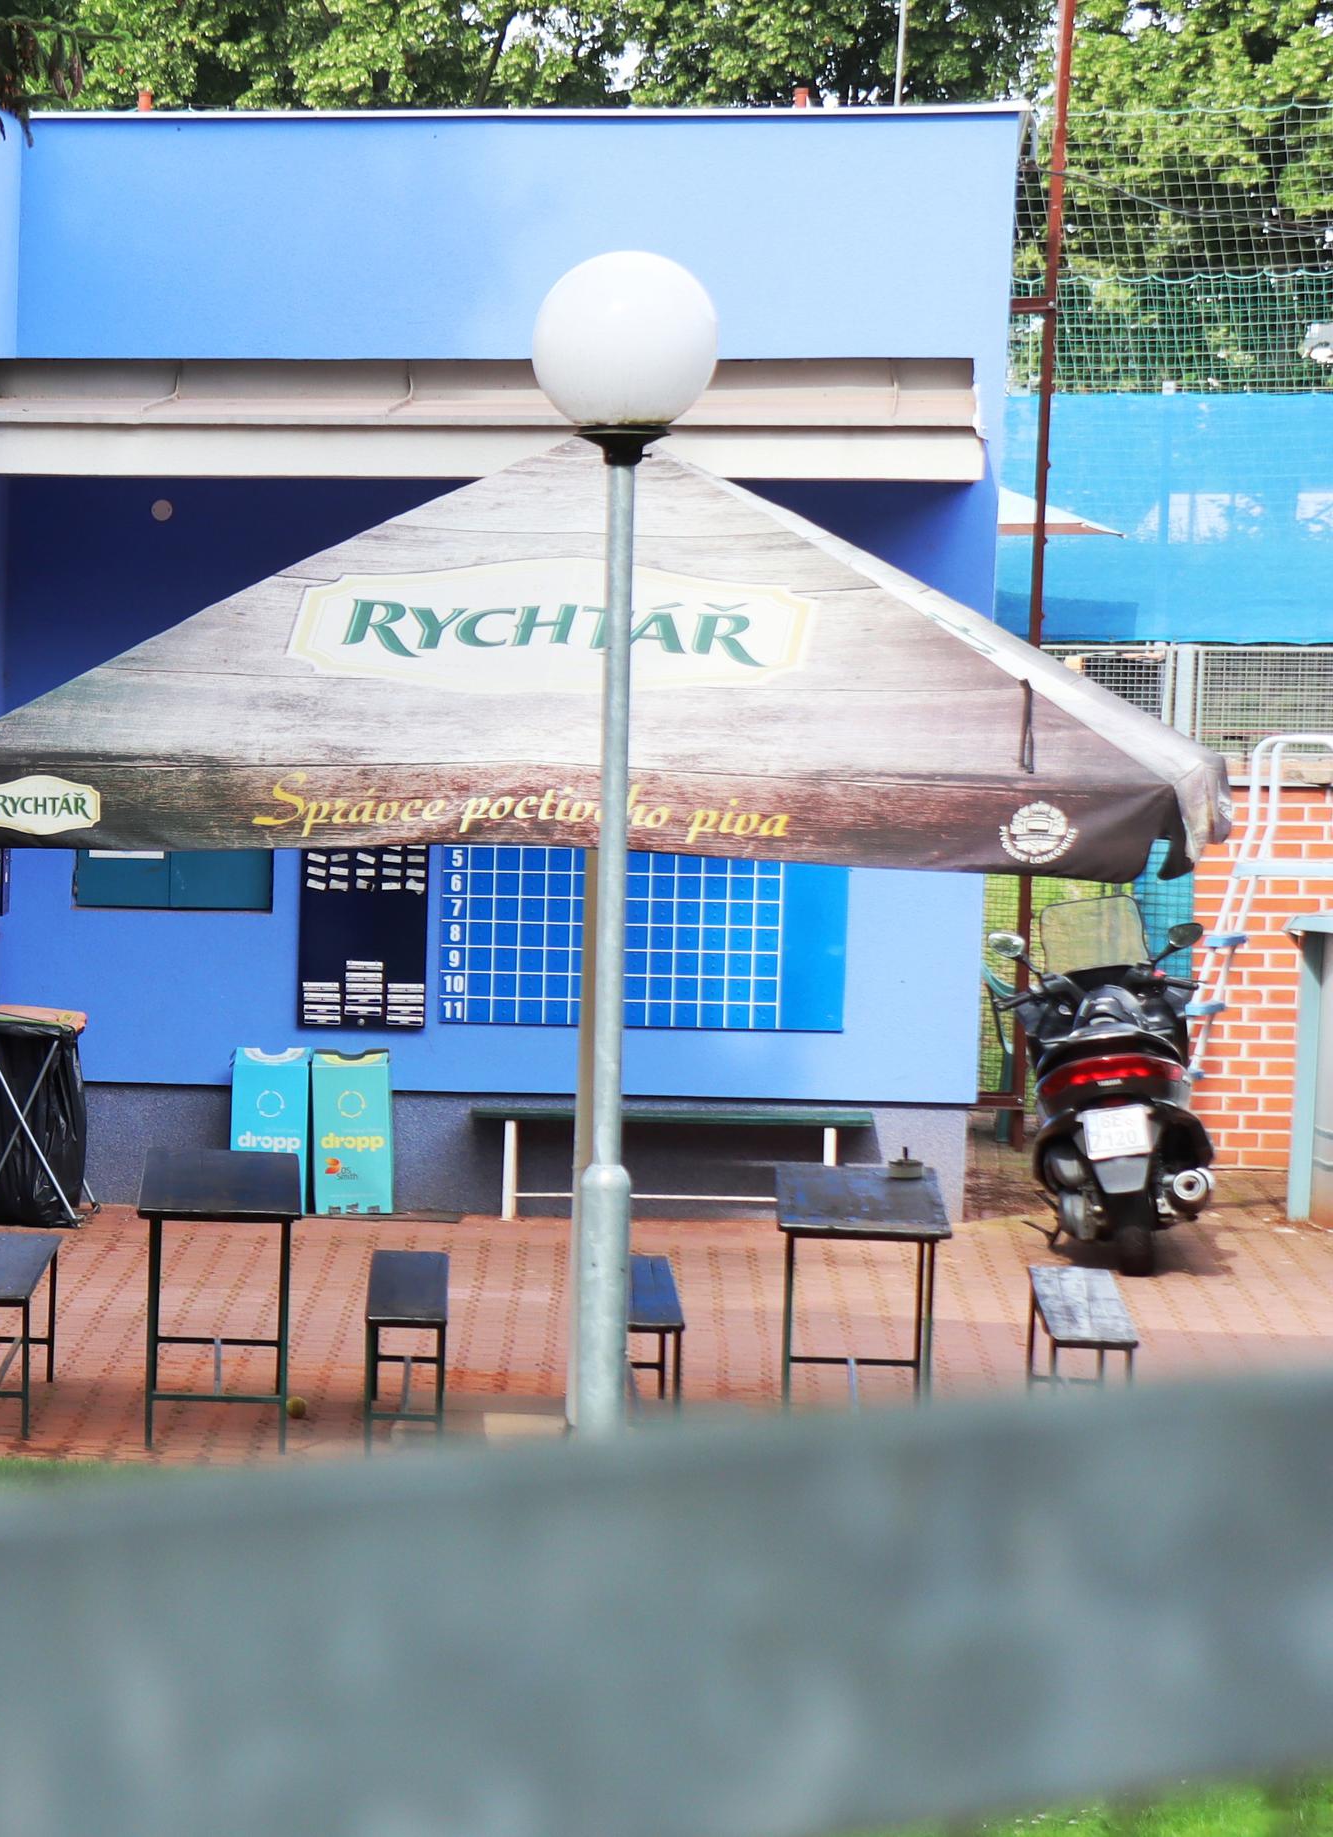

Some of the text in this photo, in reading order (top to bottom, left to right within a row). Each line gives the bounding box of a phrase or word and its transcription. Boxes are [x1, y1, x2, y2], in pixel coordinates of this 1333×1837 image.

[342, 599, 768, 667] RYCHTÁŘ
[252, 771, 790, 843] Správce poctivho piva
[452, 849, 463, 867] 5
[450, 874, 462, 892] 6
[451, 899, 462, 916] 7
[449, 924, 461, 942] 8
[448, 950, 460, 968] 9
[443, 975, 464, 993] 10
[443, 1001, 462, 1019] 11
[238, 1131, 301, 1153] dropp
[321, 1132, 385, 1152] dropp
[336, 1173, 358, 1181] Smith
